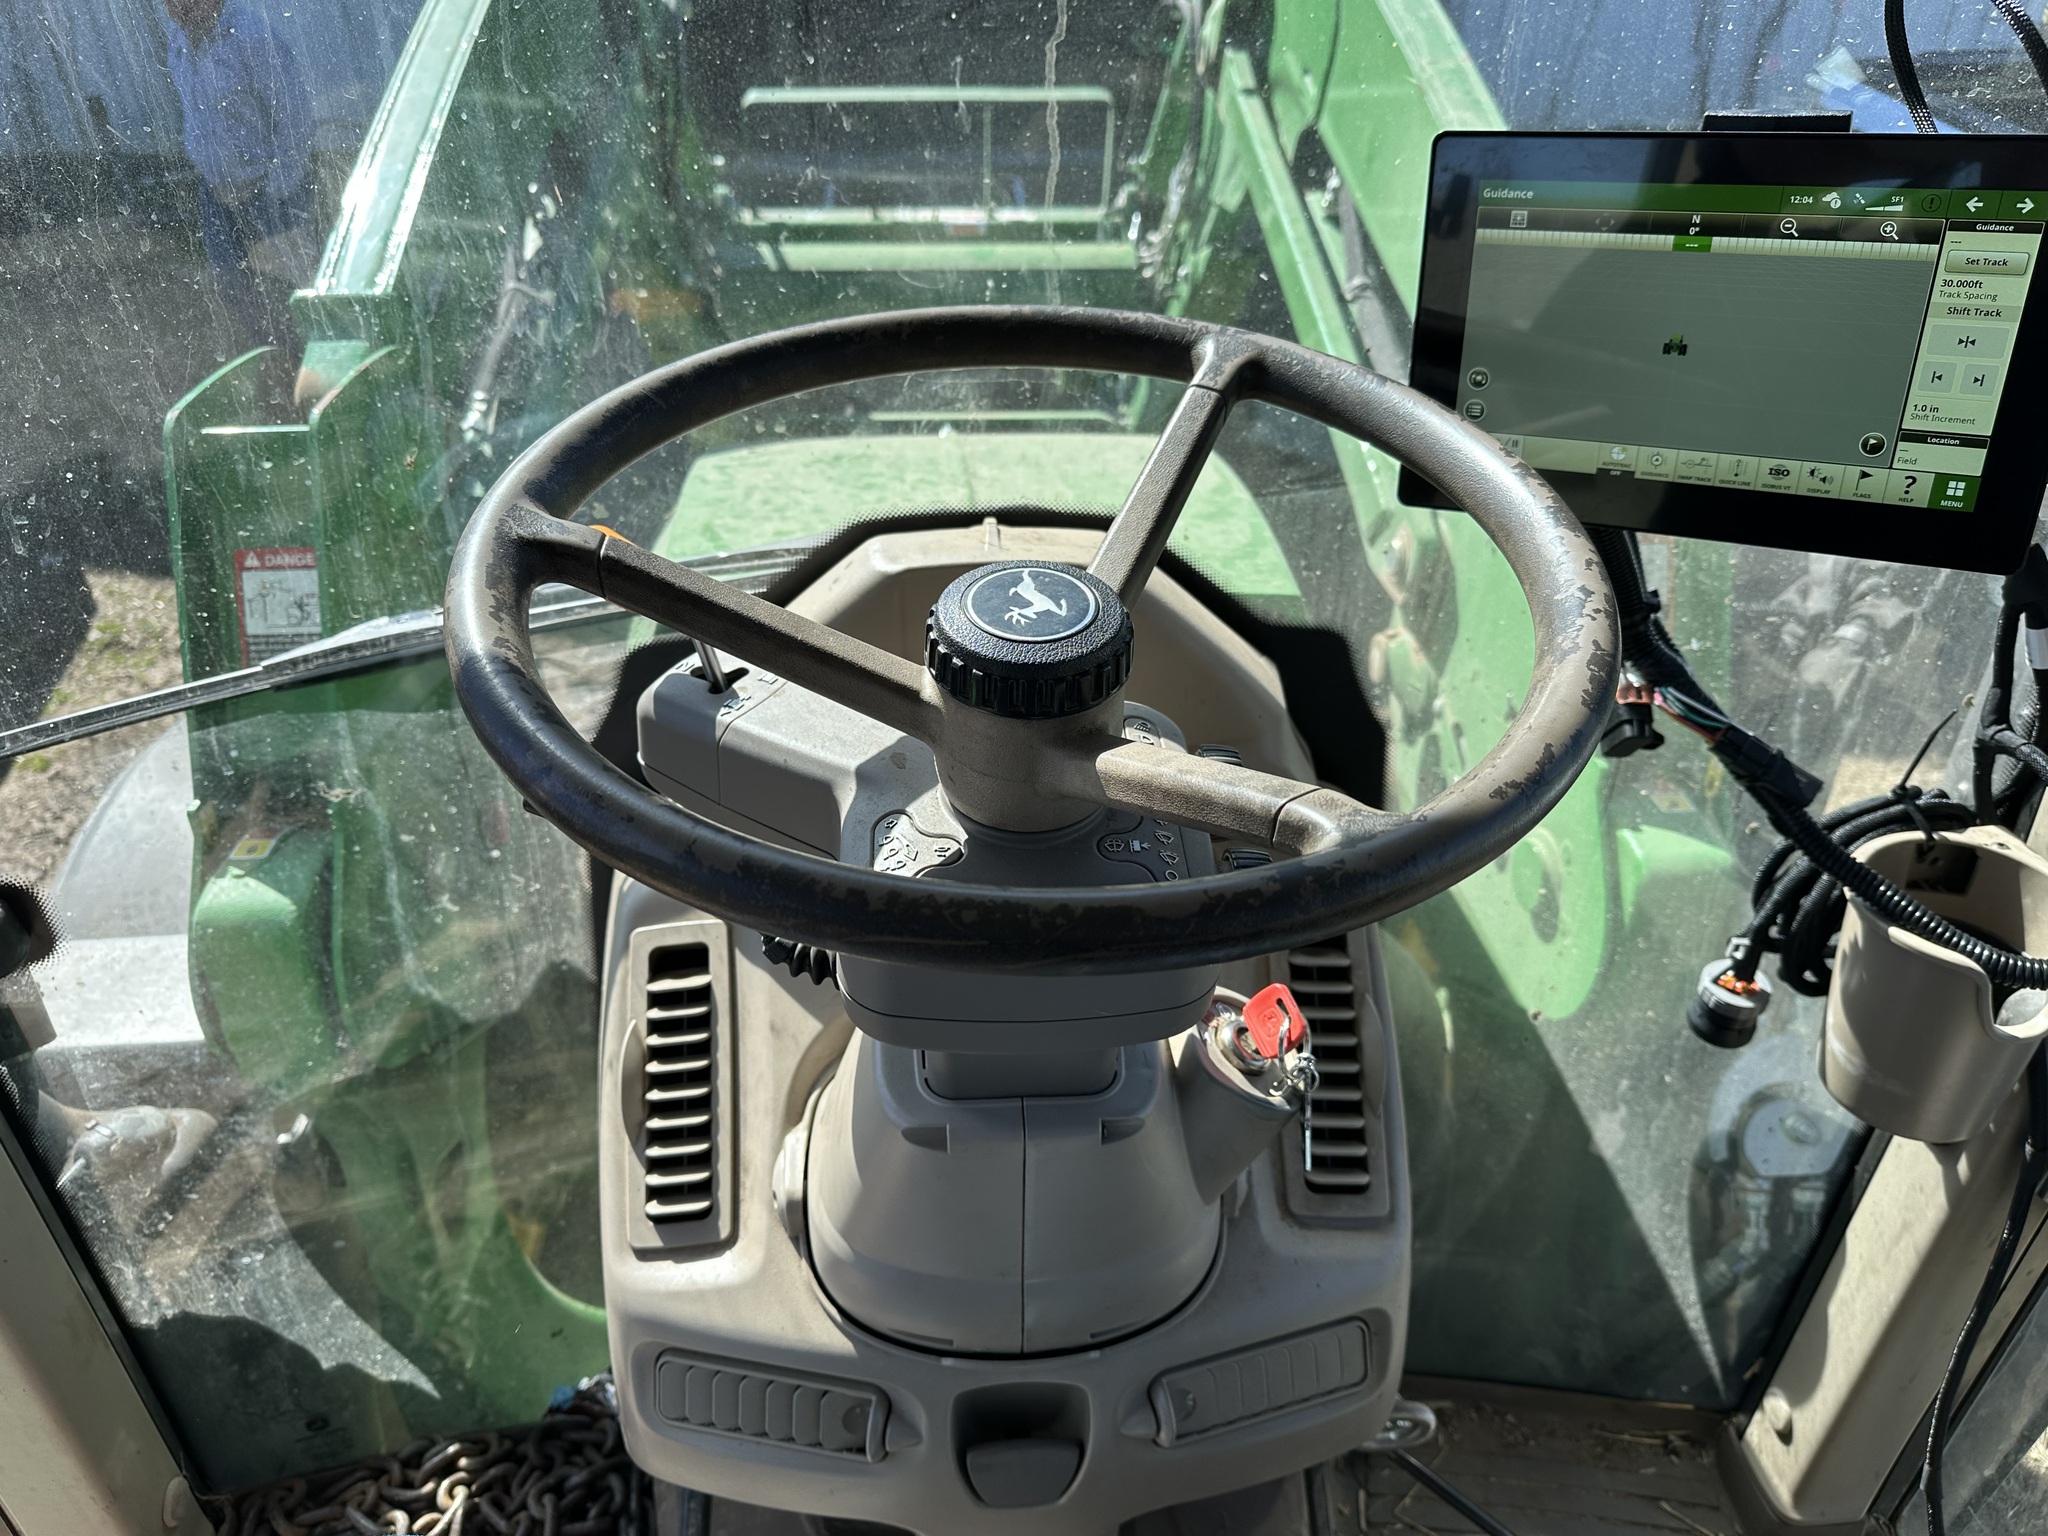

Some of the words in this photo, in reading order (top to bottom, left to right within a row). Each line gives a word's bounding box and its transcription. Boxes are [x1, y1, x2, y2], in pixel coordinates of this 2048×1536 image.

[1483, 188, 1534, 199] Guidance
[1790, 195, 1813, 204] 12:04
[1692, 215, 1701, 224] N
[1976, 223, 2015, 232] Guidance
[1965, 257, 1980, 266] Set
[1982, 258, 2009, 267] Track
[1941, 279, 1983, 289] 30.000ft
[1939, 290, 1961, 299] Track
[1964, 291, 1998, 302] Spacing
[1947, 306, 1971, 316] Shift
[1974, 308, 2002, 317] Track
[1912, 404, 1928, 413] 1.0
[1929, 405, 1940, 413] in
[1910, 412, 1929, 422] Shift
[1931, 415, 1976, 425] Increment
[1927, 436, 1960, 445] Location
[1897, 456, 1918, 466] Field
[1768, 467, 1790, 477] ISO
[1940, 500, 1964, 508] MENU
